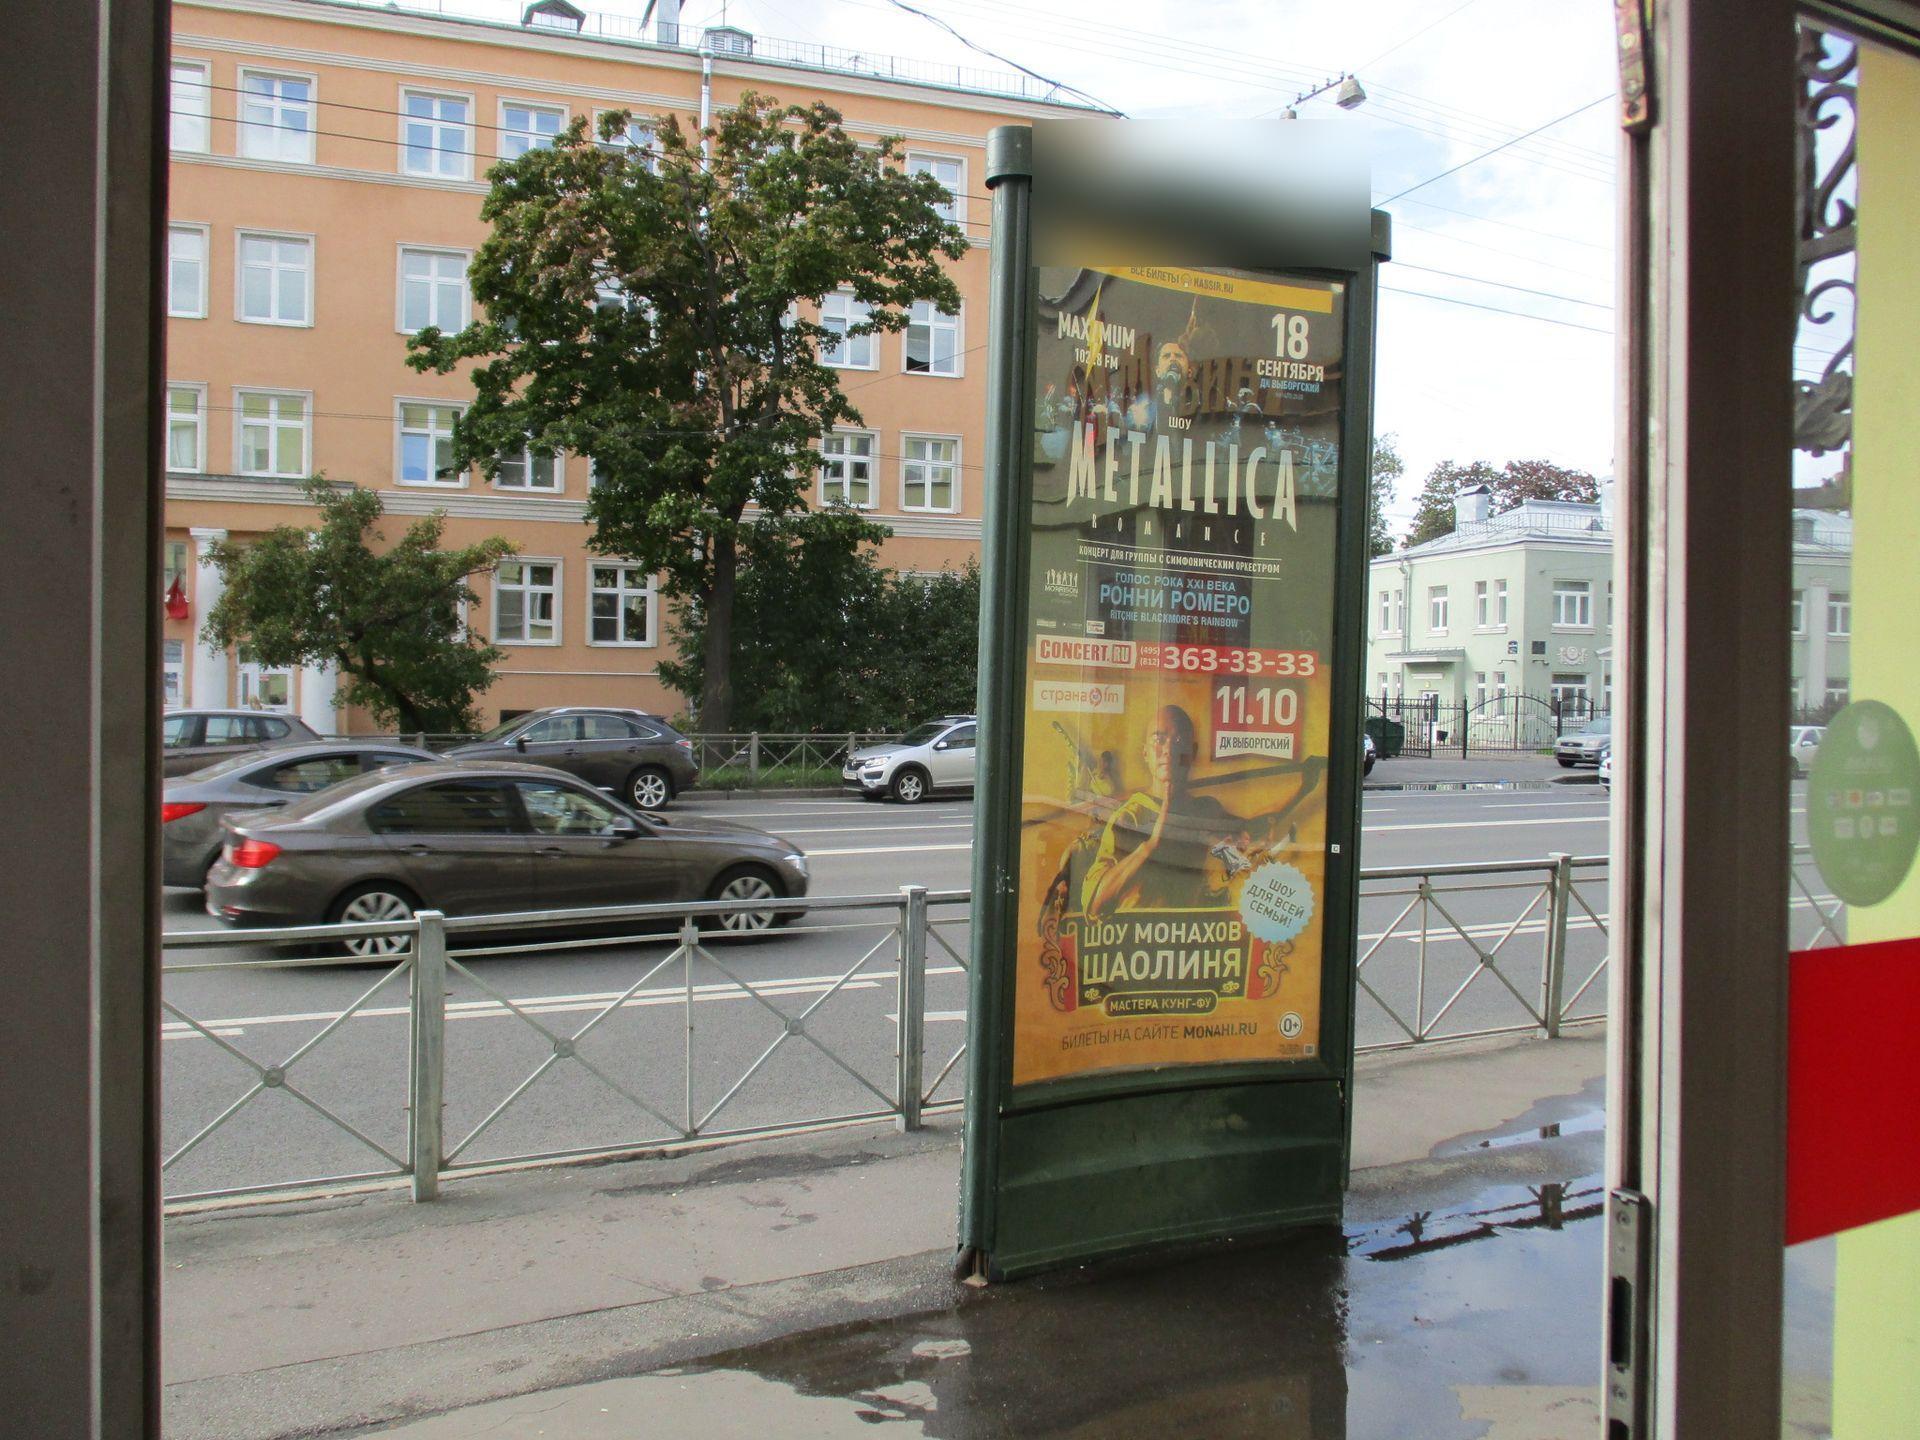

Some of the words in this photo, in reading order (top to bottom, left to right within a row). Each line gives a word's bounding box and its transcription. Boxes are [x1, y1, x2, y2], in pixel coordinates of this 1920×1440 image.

[1146, 267, 1179, 283] БИЛЕТЫ
[1271, 313, 1309, 360] 18
[1104, 353, 1119, 370] FM
[1256, 358, 1324, 382] СЕНТЯБРЯ
[1271, 379, 1320, 393] ВЫБОРГСКИЙ
[1168, 416, 1192, 431] ШОУ
[1066, 419, 1297, 533] METALLICA
[1091, 512, 1266, 547] ROMANCE
[1079, 545, 1109, 560] КОНЦЕРТ
[1110, 549, 1124, 560] ДЛЯ
[1125, 552, 1157, 563] ГРУППЫ
[1158, 554, 1164, 564] С
[1165, 555, 1234, 570] СИМФОНИЧЕСКИМ
[1235, 561, 1280, 574] ОРКЕСТРОМ
[1115, 571, 1151, 584] ГОЛОС
[1154, 576, 1183, 588] РОКА
[1186, 578, 1204, 589] XXI
[1206, 580, 1236, 592] ВЕКА
[1100, 583, 1164, 609] РОННИ
[1171, 590, 1250, 615] РОМЕРО
[1110, 609, 1138, 622] RITCHIE
[1140, 610, 1199, 626] BLACKMORE'S
[1201, 614, 1239, 628] RAINBOW
[1040, 639, 1132, 665] CONCERT.RU
[1140, 657, 1160, 667] (812)
[1163, 646, 1315, 676] 363-33-33
[1040, 688, 1088, 704] страна
[1216, 685, 1297, 726] 11.10
[1220, 736, 1231, 749] ДК
[1232, 736, 1290, 750] ВЫБОРГСКИЙ
[1269, 879, 1296, 897] ШОУ
[1247, 884, 1274, 903] ДЛЯ
[1274, 896, 1305, 919] ВСЕЙ
[1249, 900, 1292, 928] СЕМЬИ!
[1083, 922, 1128, 948] ШОУ
[1134, 920, 1241, 944] МОНАХОВ
[1082, 948, 1241, 985] ШАОЛИНЯ
[1110, 998, 1158, 1012] МАСТЕРА
[1161, 997, 1212, 1010] КУНГ-ФУ
[1061, 1028, 1110, 1050] БИЛЕТЫ
[1113, 1028, 1131, 1042] НА
[1134, 1023, 1180, 1041] САЙТЕ
[1183, 1022, 1258, 1039] MONAHI.RU
[1283, 1018, 1299, 1033] 0+
